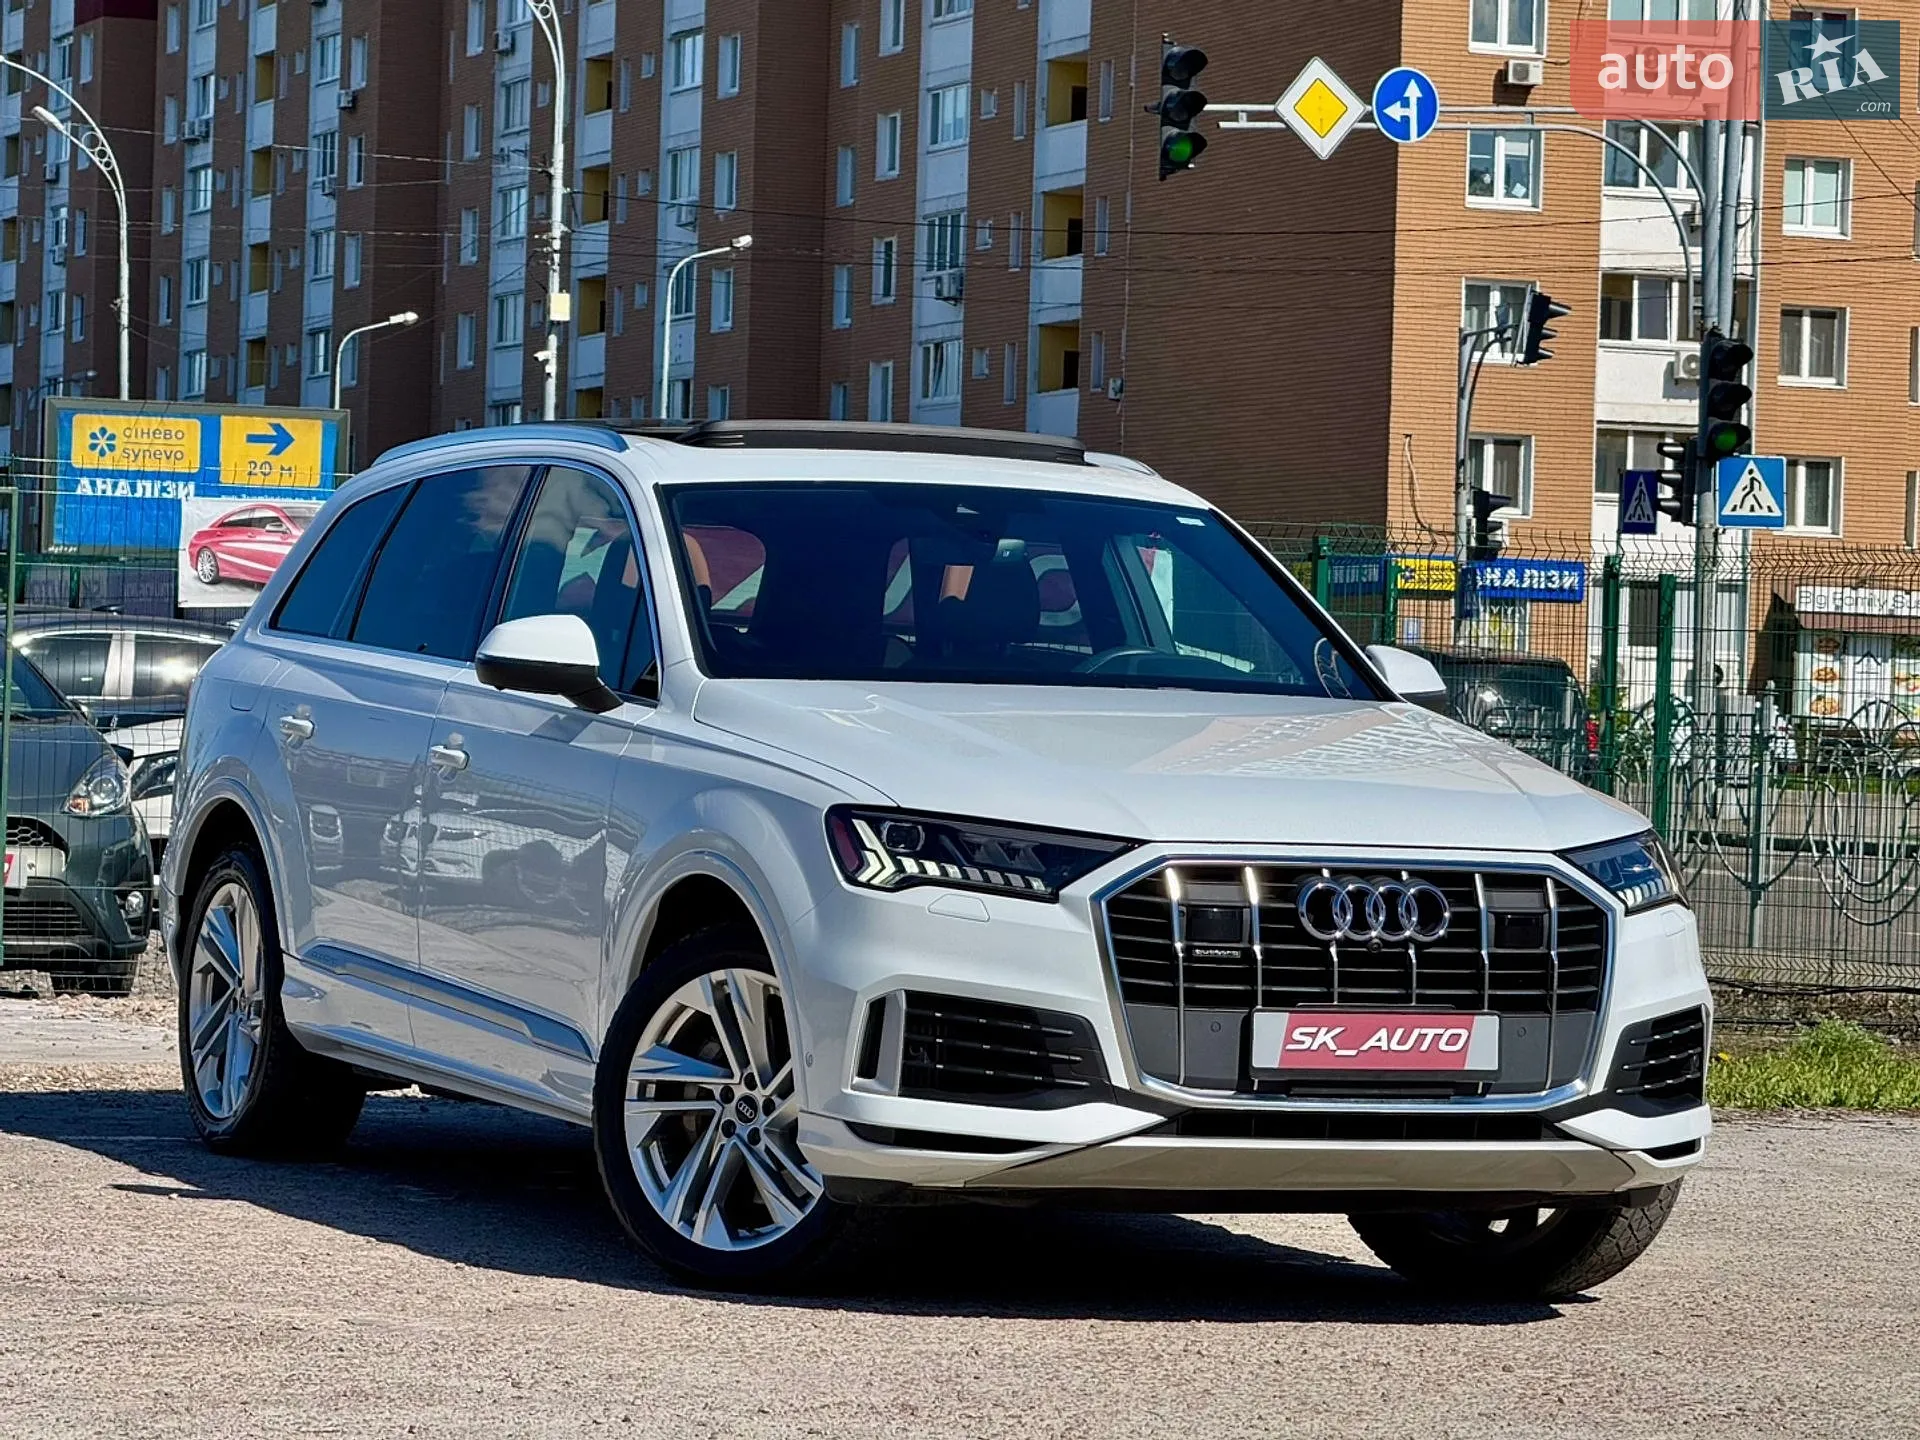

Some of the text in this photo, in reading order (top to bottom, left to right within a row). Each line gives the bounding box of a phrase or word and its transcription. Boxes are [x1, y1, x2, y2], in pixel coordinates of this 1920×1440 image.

[122, 446, 185, 463] synevo
[246, 460, 273, 477] 20
[75, 477, 196, 500] АНАЛІЗИ
[1285, 1026, 1470, 1056] SK_AUTO
